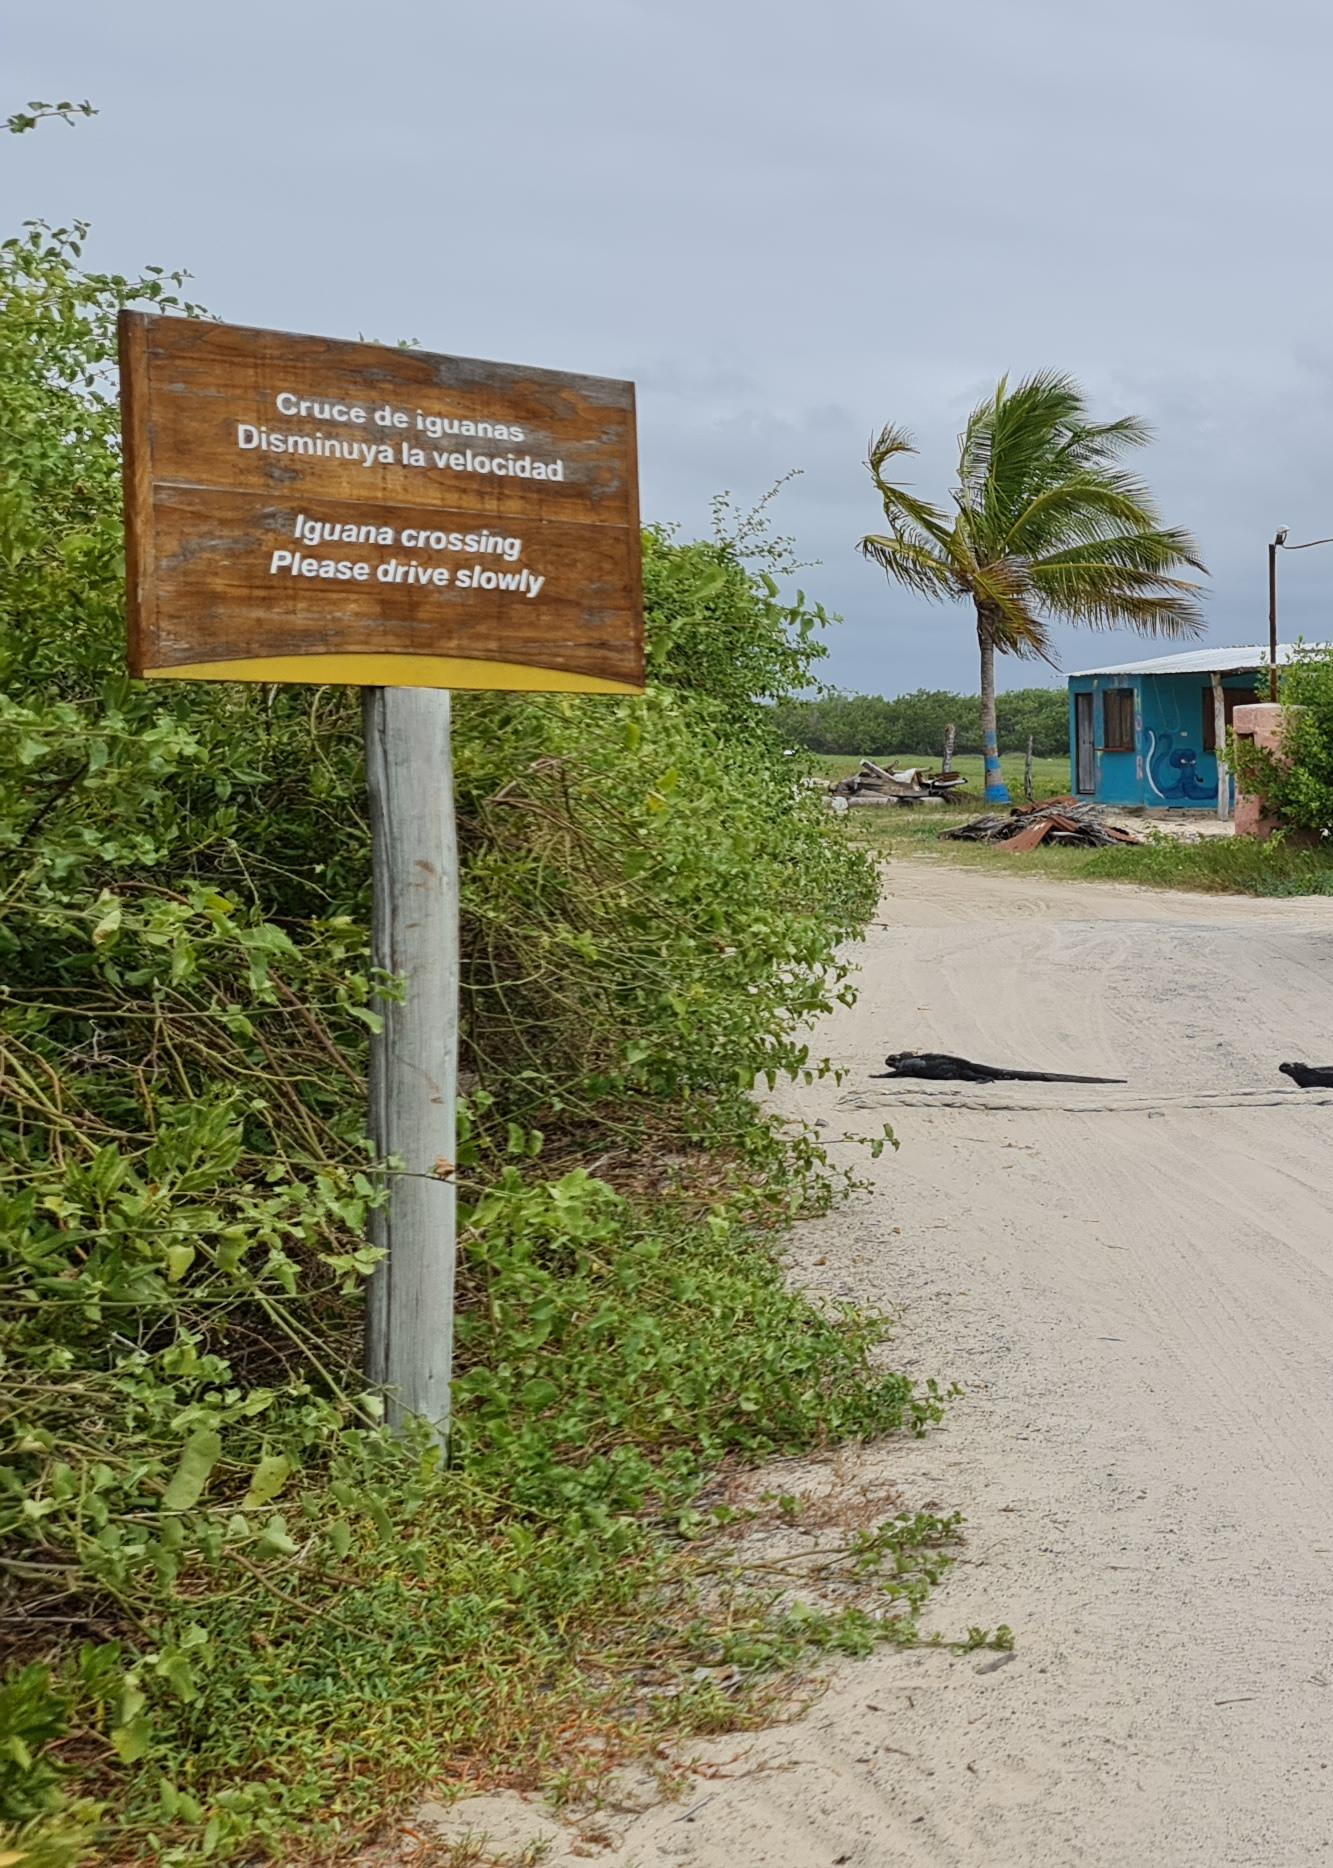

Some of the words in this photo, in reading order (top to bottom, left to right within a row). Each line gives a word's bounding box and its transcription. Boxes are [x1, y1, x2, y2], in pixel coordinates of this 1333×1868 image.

[276, 392, 367, 424] Cruce
[374, 405, 409, 428] de
[416, 409, 525, 443] iguanas
[237, 423, 395, 467] Disminuya
[401, 442, 426, 467] la
[433, 449, 565, 482] velocidad
[294, 514, 394, 546] Iguana
[401, 529, 522, 561] crossing
[270, 550, 369, 580] Please
[376, 559, 449, 586] drive
[455, 565, 545, 598] slowly
